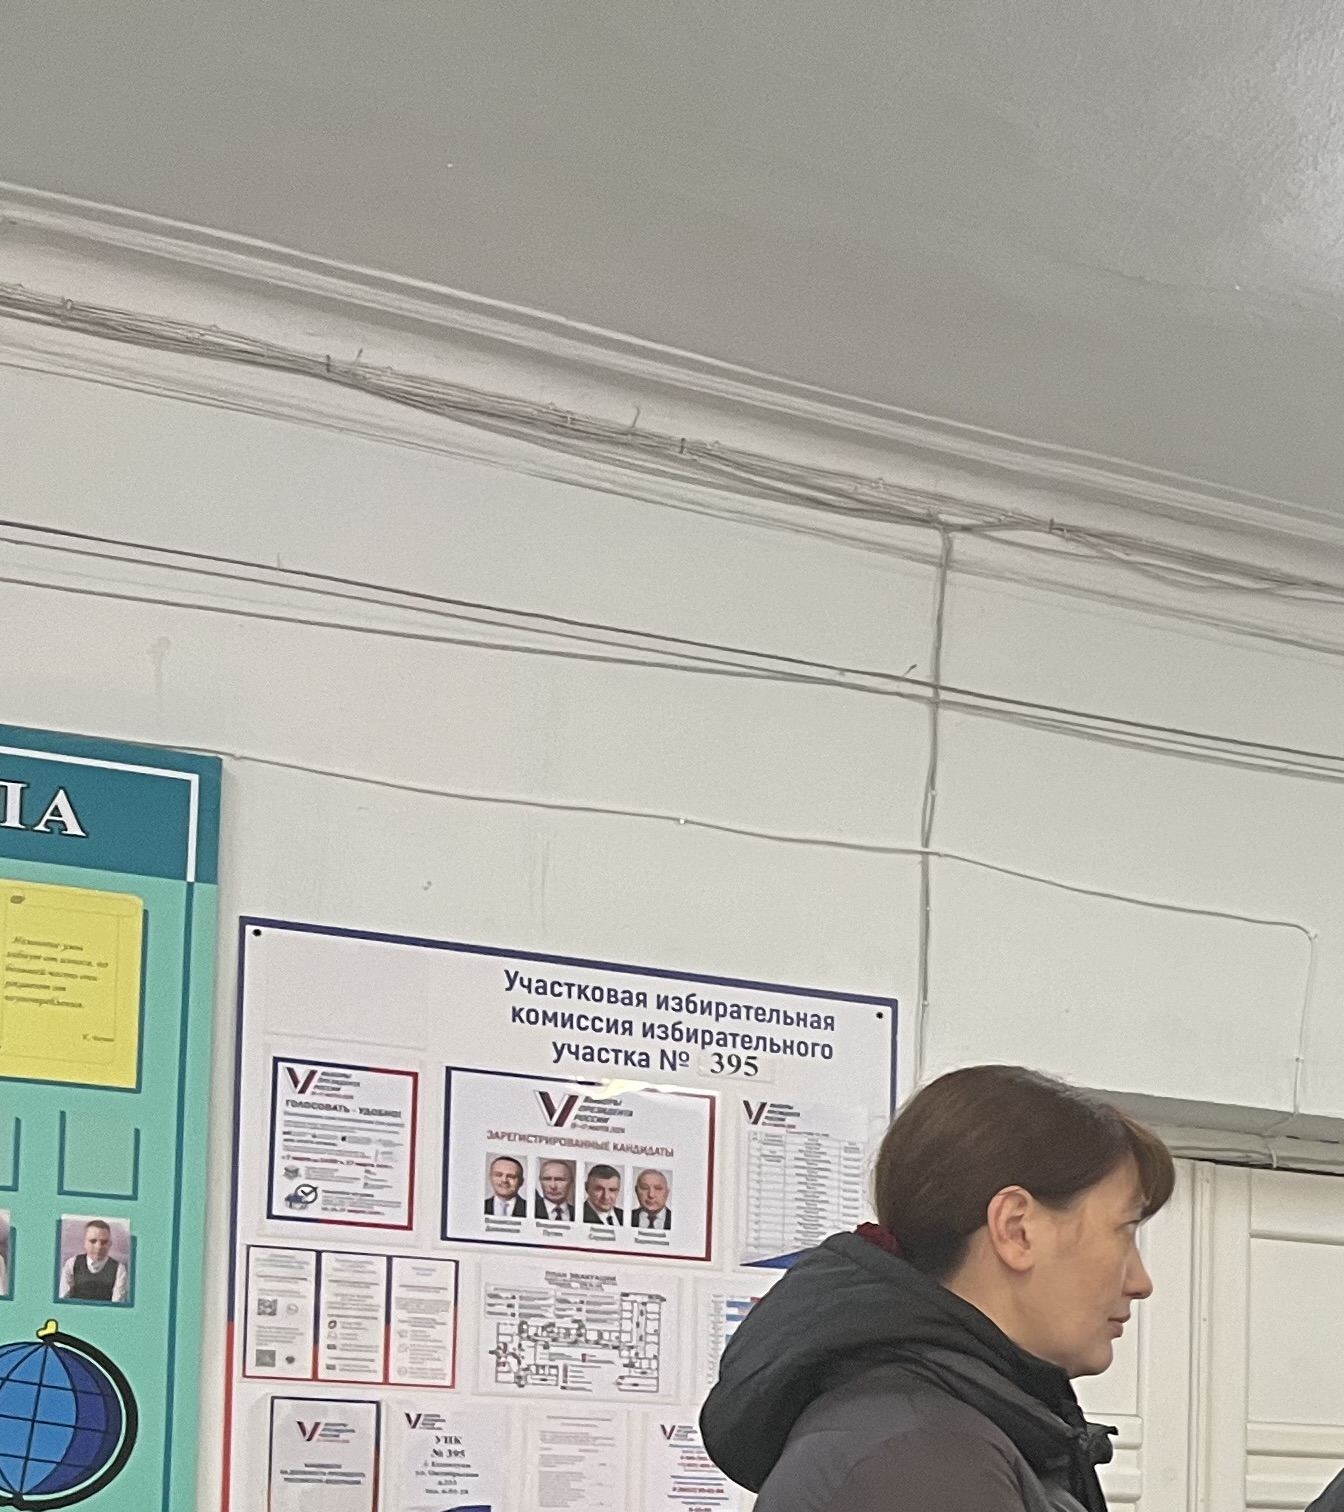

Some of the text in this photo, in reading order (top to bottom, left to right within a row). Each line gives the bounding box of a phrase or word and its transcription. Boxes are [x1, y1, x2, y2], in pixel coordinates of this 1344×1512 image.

[504, 969, 836, 1031] Участковая избирательная
[511, 1006, 834, 1059] комиссия избирательного
[552, 1041, 760, 1077] участка № 395
